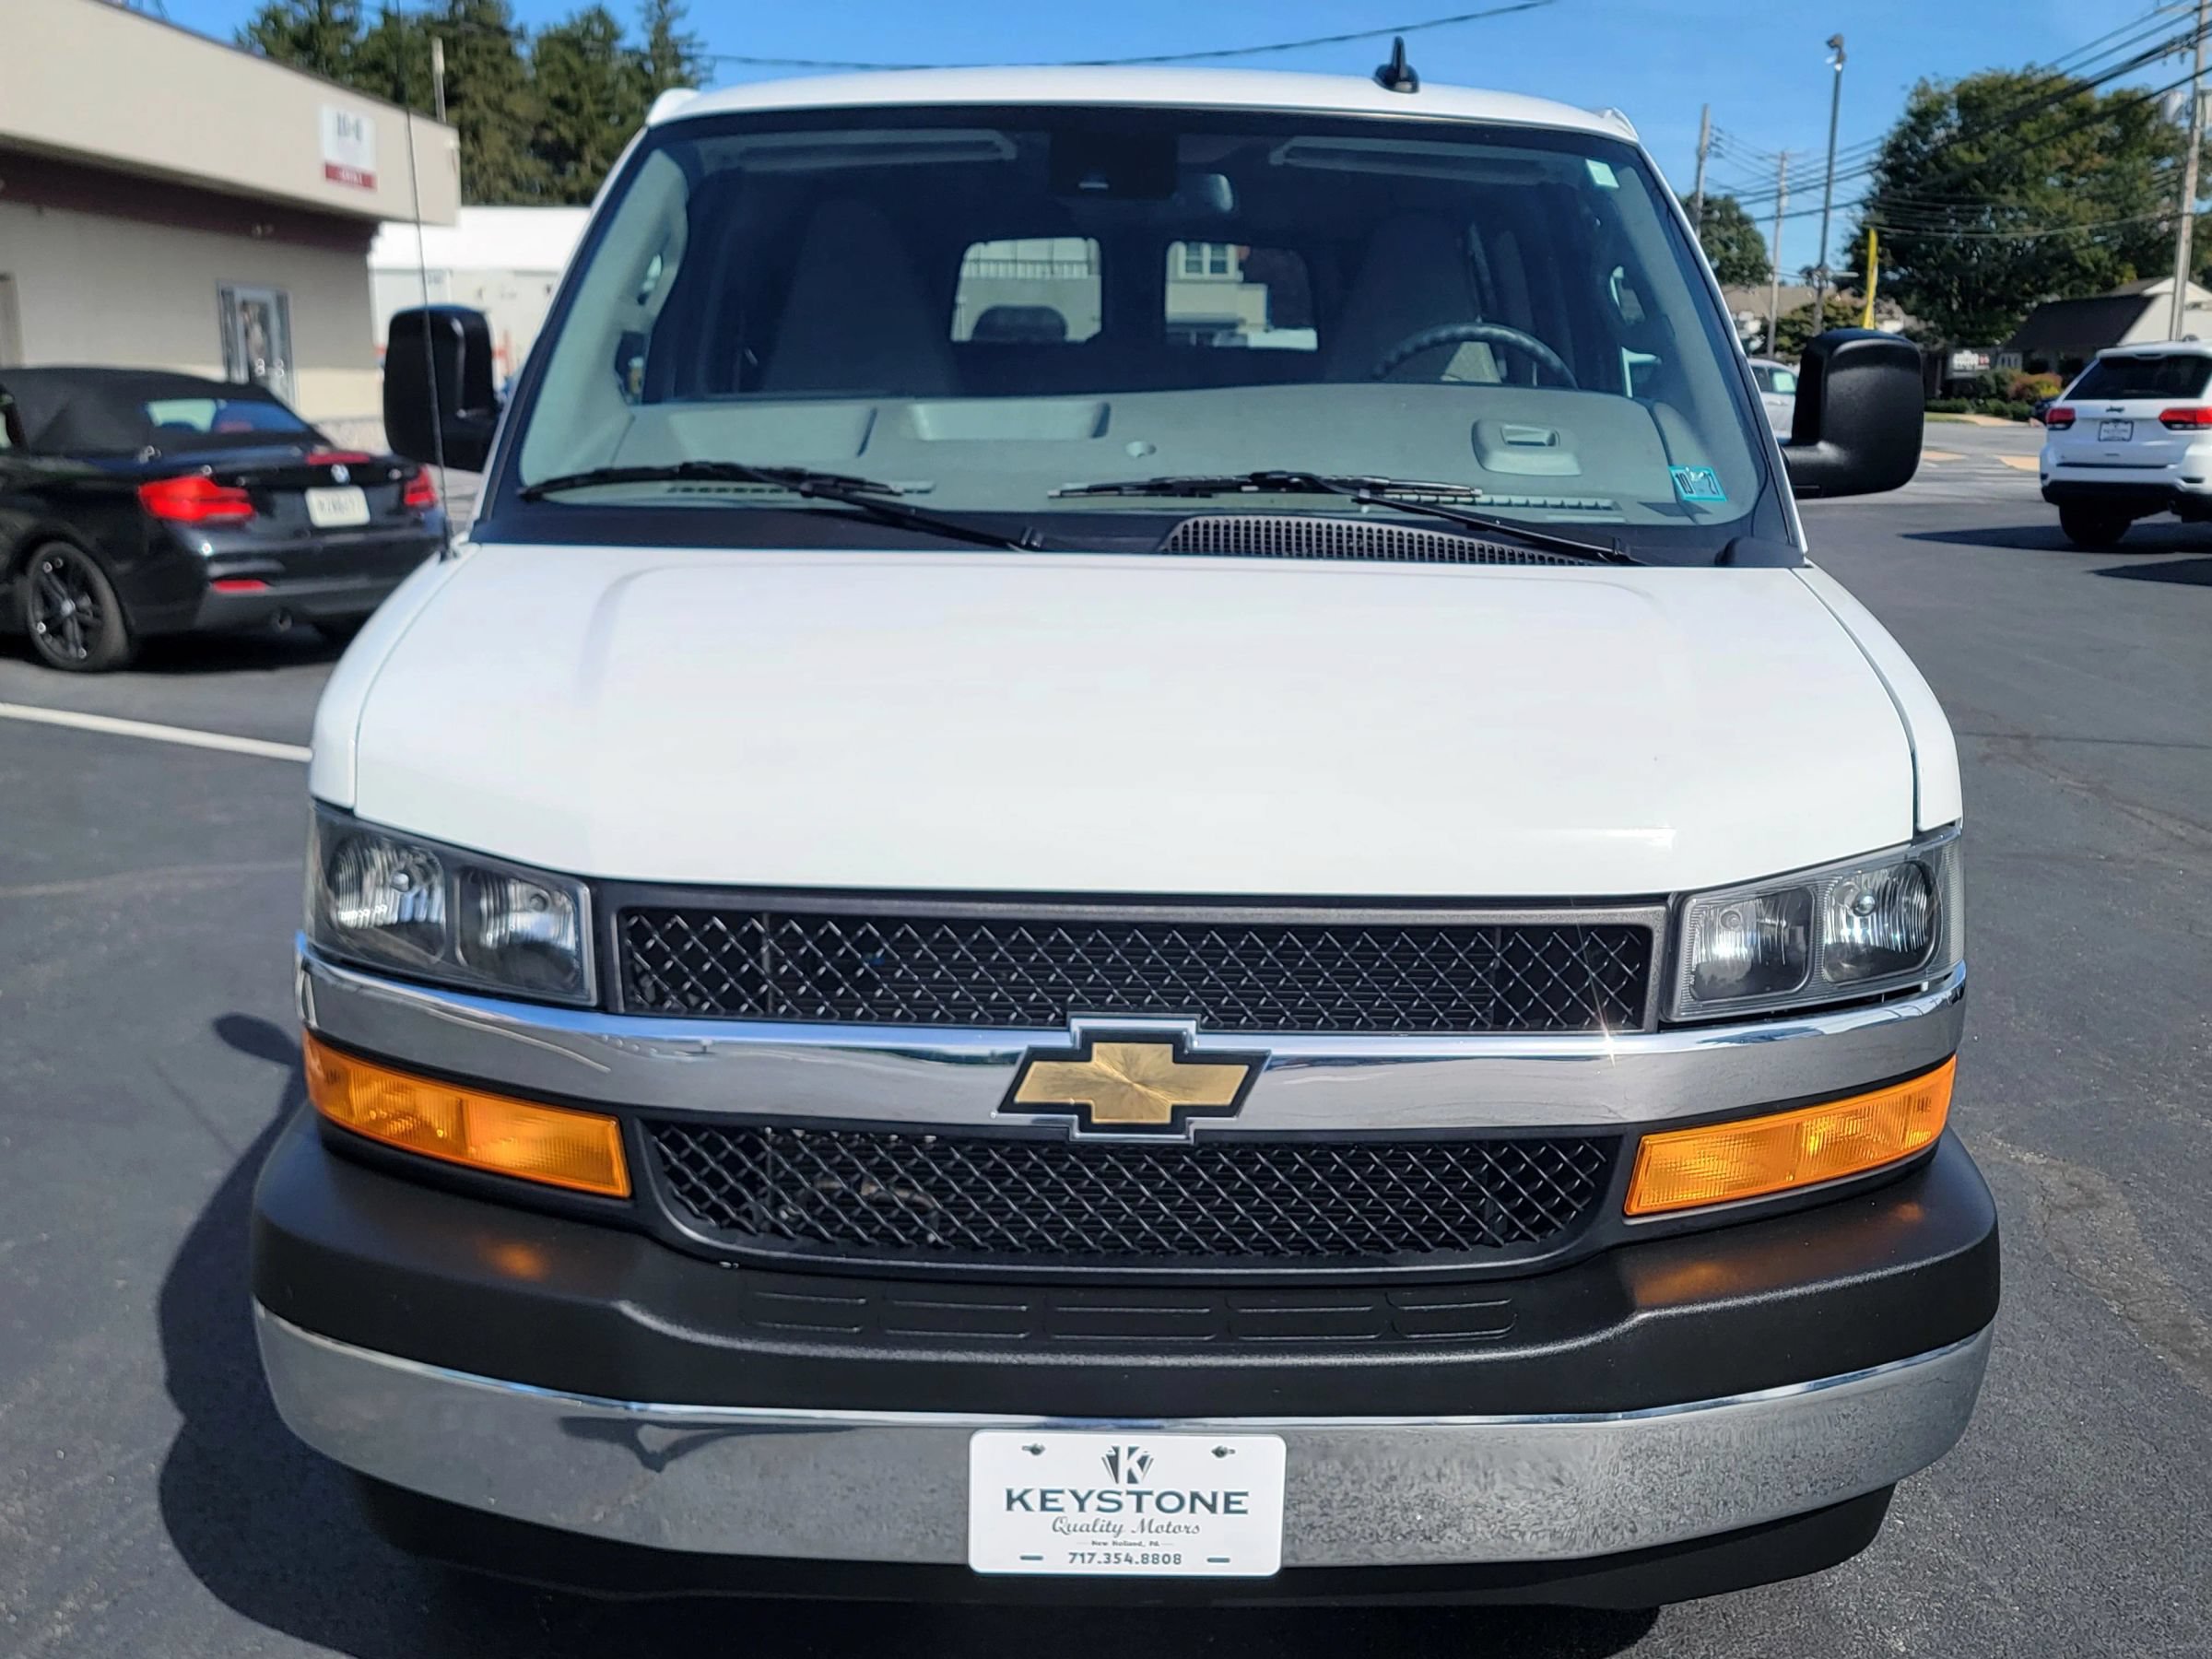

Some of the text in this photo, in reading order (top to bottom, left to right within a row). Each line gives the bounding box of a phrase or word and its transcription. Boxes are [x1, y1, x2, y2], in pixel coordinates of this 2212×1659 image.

[1675, 472, 1695, 495] 10
[1006, 1488, 1249, 1515] KEYSTONE
[1052, 1516, 1200, 1538] Quality Motors
[1068, 1551, 1182, 1566] 717.354.8808
